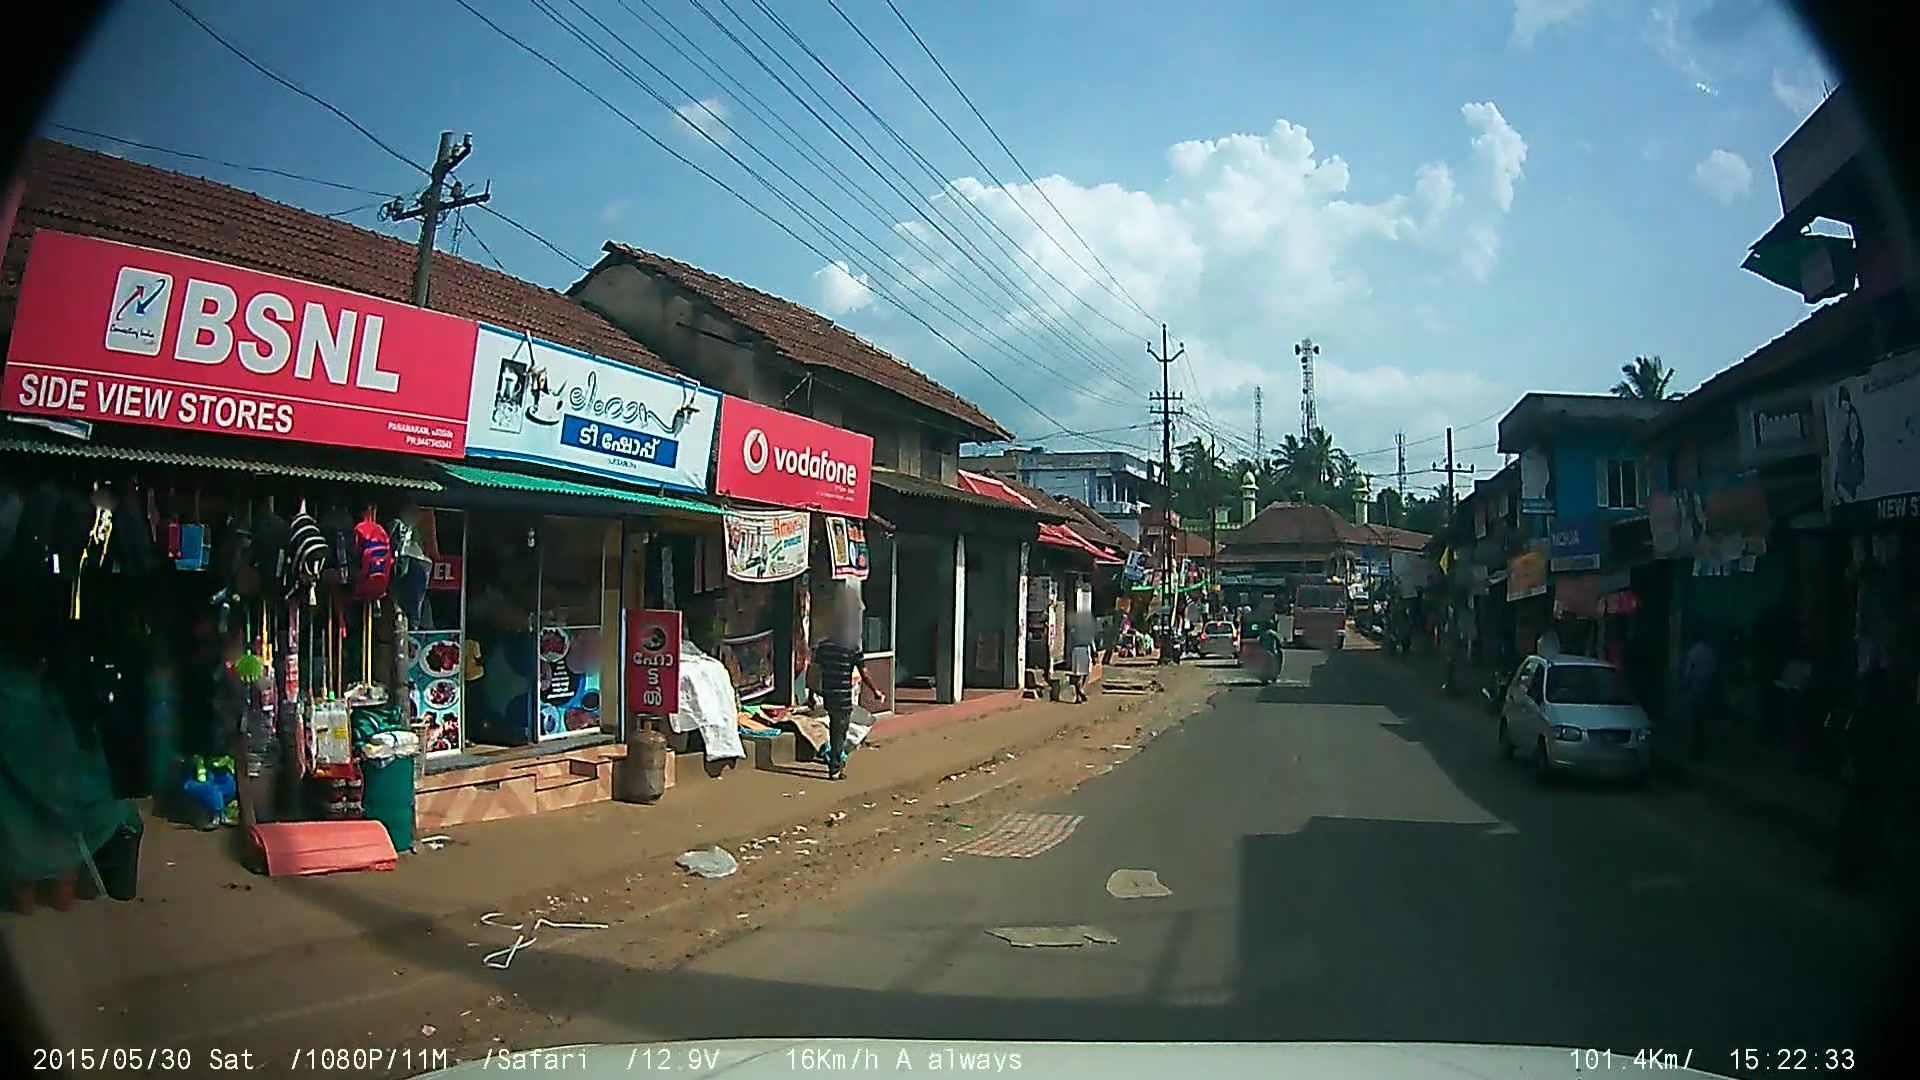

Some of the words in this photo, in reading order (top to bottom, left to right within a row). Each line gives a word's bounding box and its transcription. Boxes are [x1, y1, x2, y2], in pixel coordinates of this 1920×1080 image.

[174, 279, 400, 394] BSNL
[19, 373, 87, 411] SIDE
[96, 381, 174, 421] VIEW
[177, 391, 294, 434] STORES
[773, 446, 857, 487] vodafone
